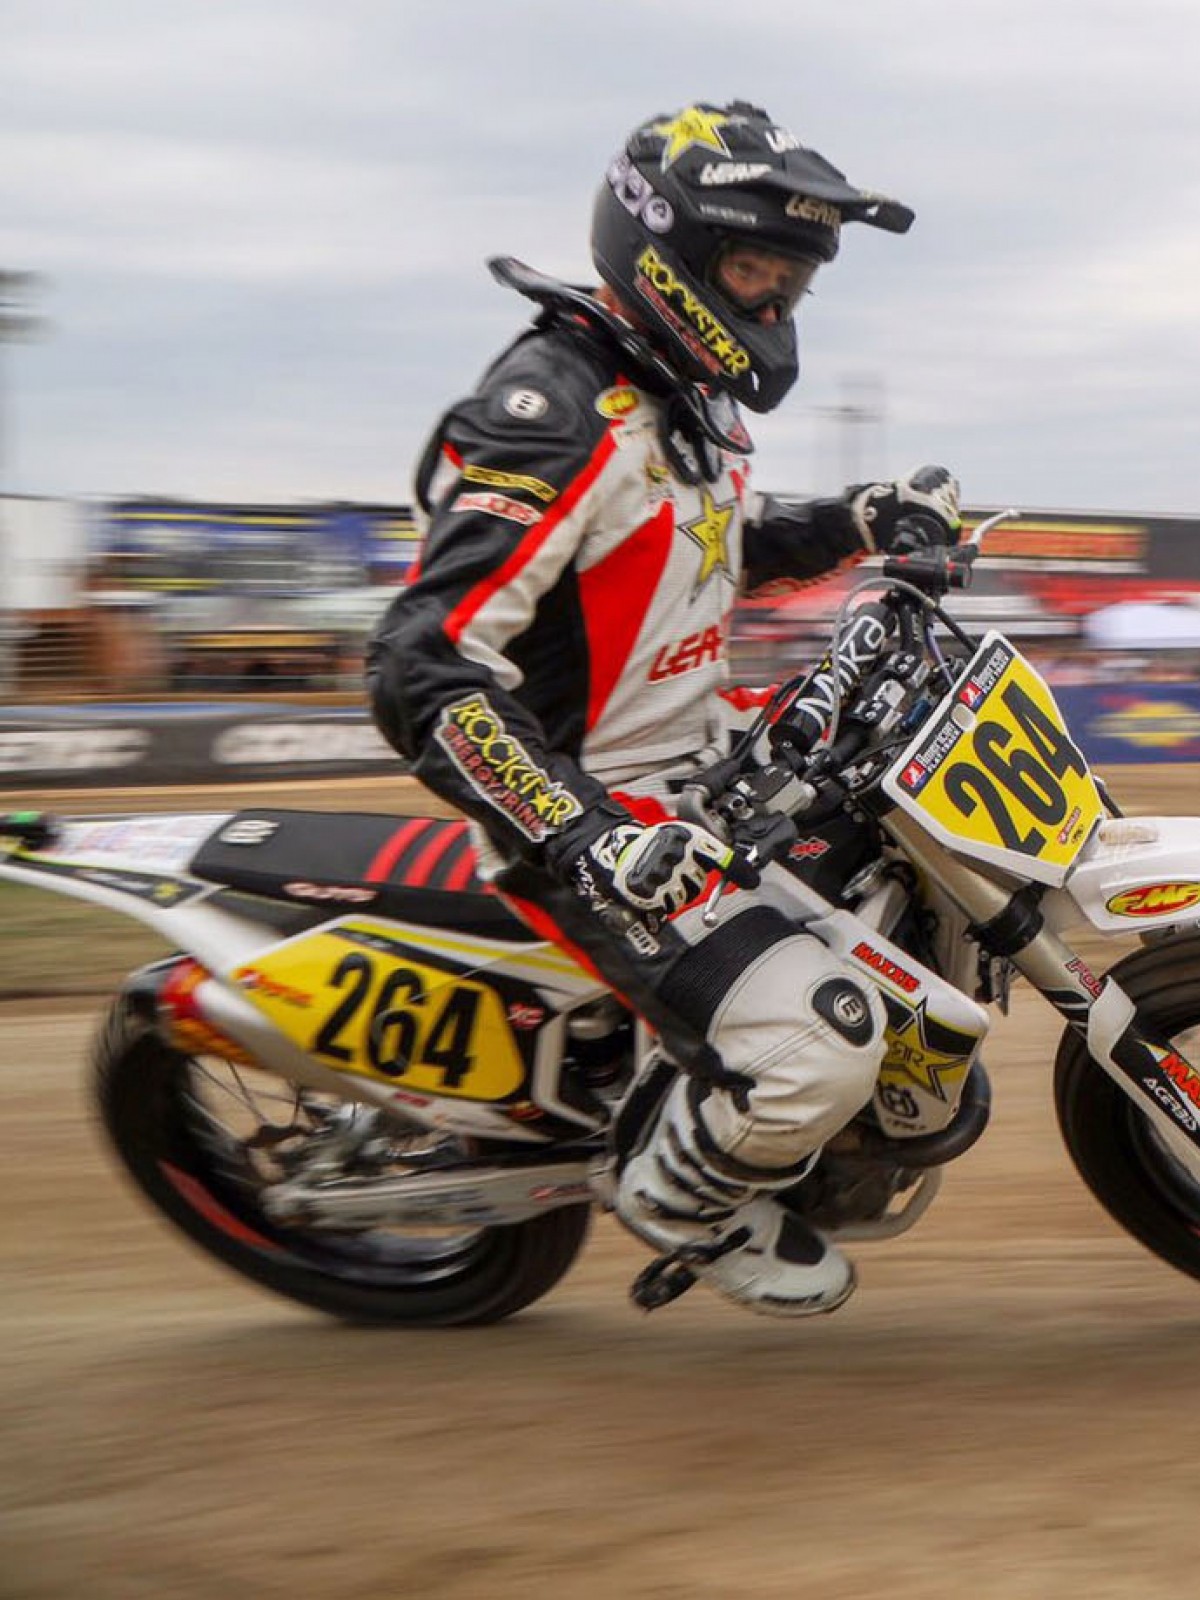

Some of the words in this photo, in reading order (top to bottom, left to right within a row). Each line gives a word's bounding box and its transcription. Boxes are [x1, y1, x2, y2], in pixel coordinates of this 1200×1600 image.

[648, 614, 728, 682] LEA
[944, 679, 1088, 857] 264
[851, 941, 921, 993] MAXXIS
[313, 952, 481, 1088] 264
